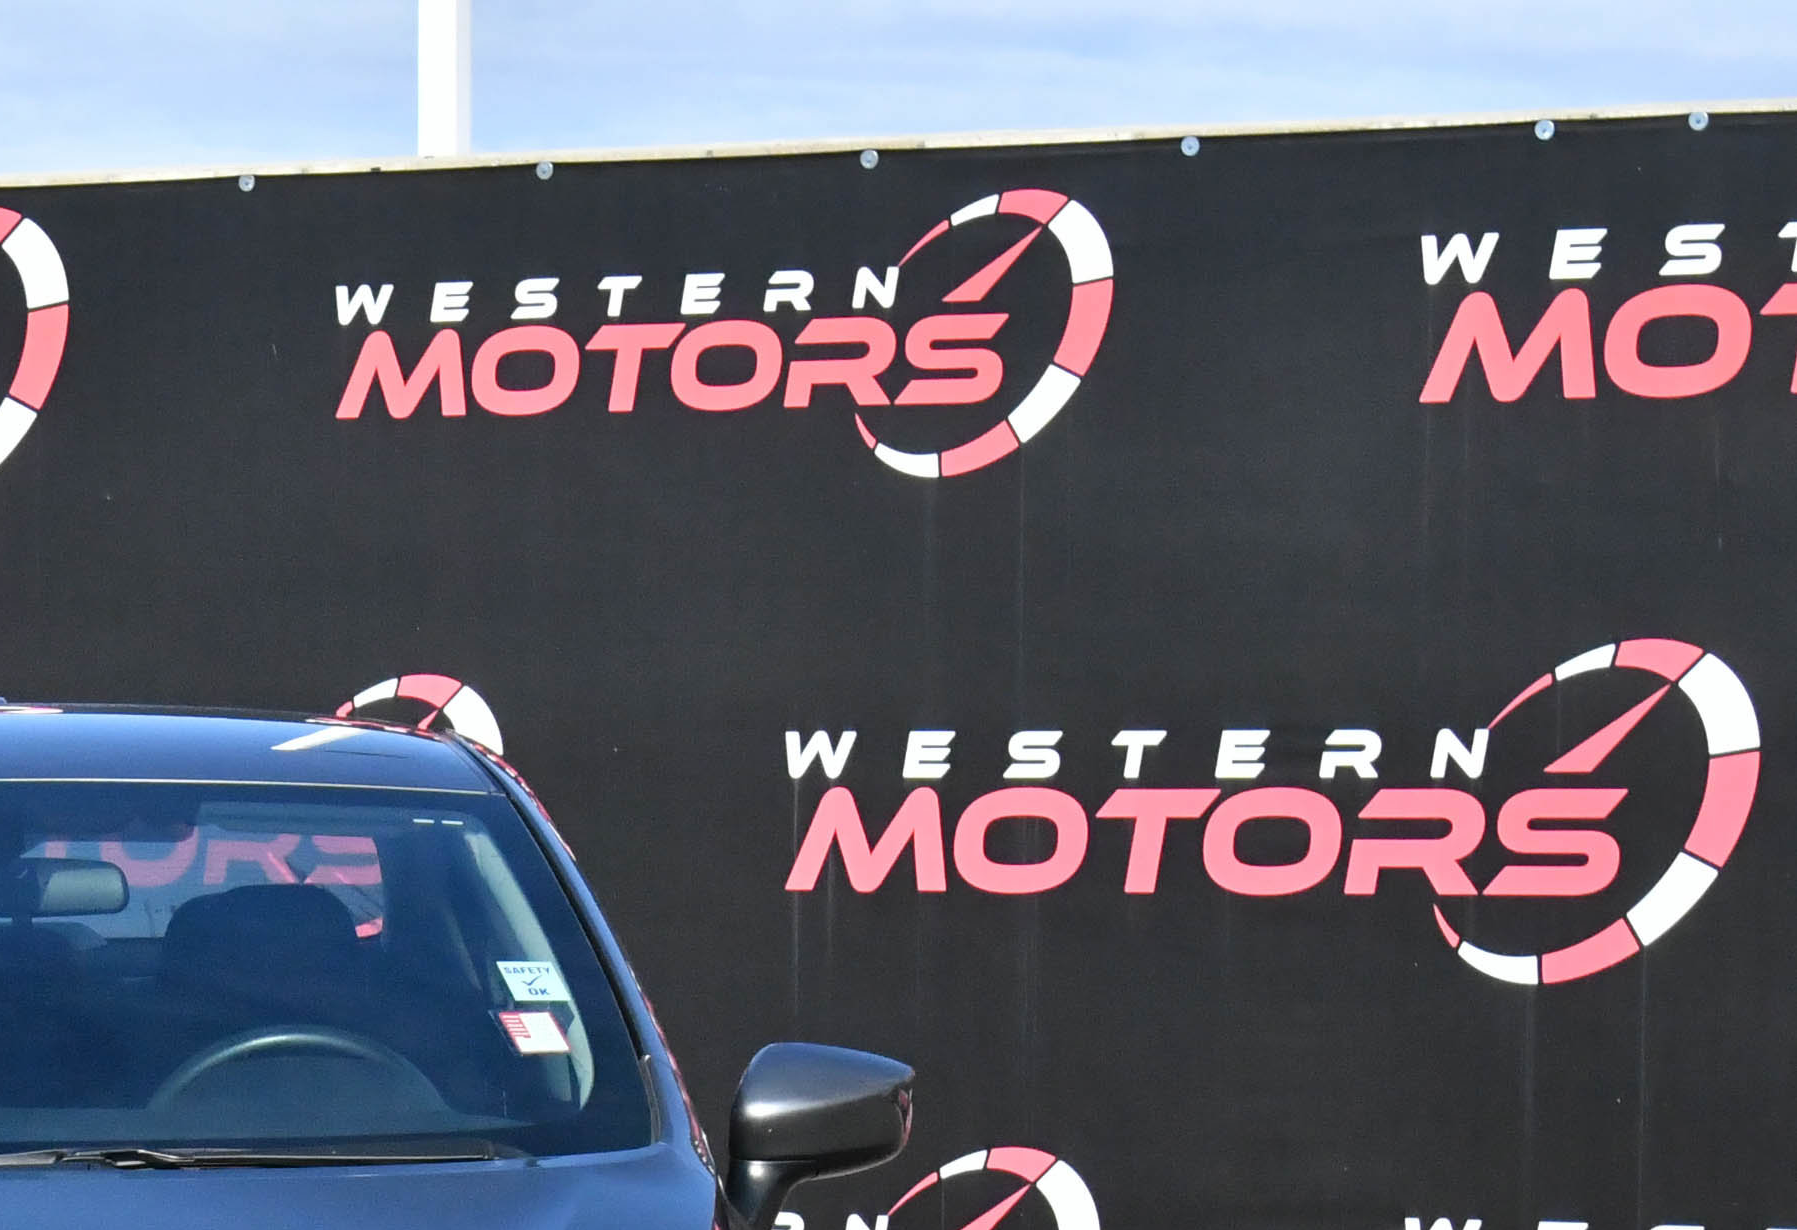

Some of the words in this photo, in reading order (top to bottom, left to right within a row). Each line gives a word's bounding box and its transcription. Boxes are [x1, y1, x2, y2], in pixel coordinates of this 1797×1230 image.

[335, 266, 900, 326] WESTERN
[335, 313, 1010, 420] MOTORS
[1419, 283, 1797, 403] MO
[785, 727, 1490, 780] WESTERN
[784, 786, 1629, 897] MOTORS
[503, 966, 551, 975] SAFETY
[527, 987, 551, 996] OK
